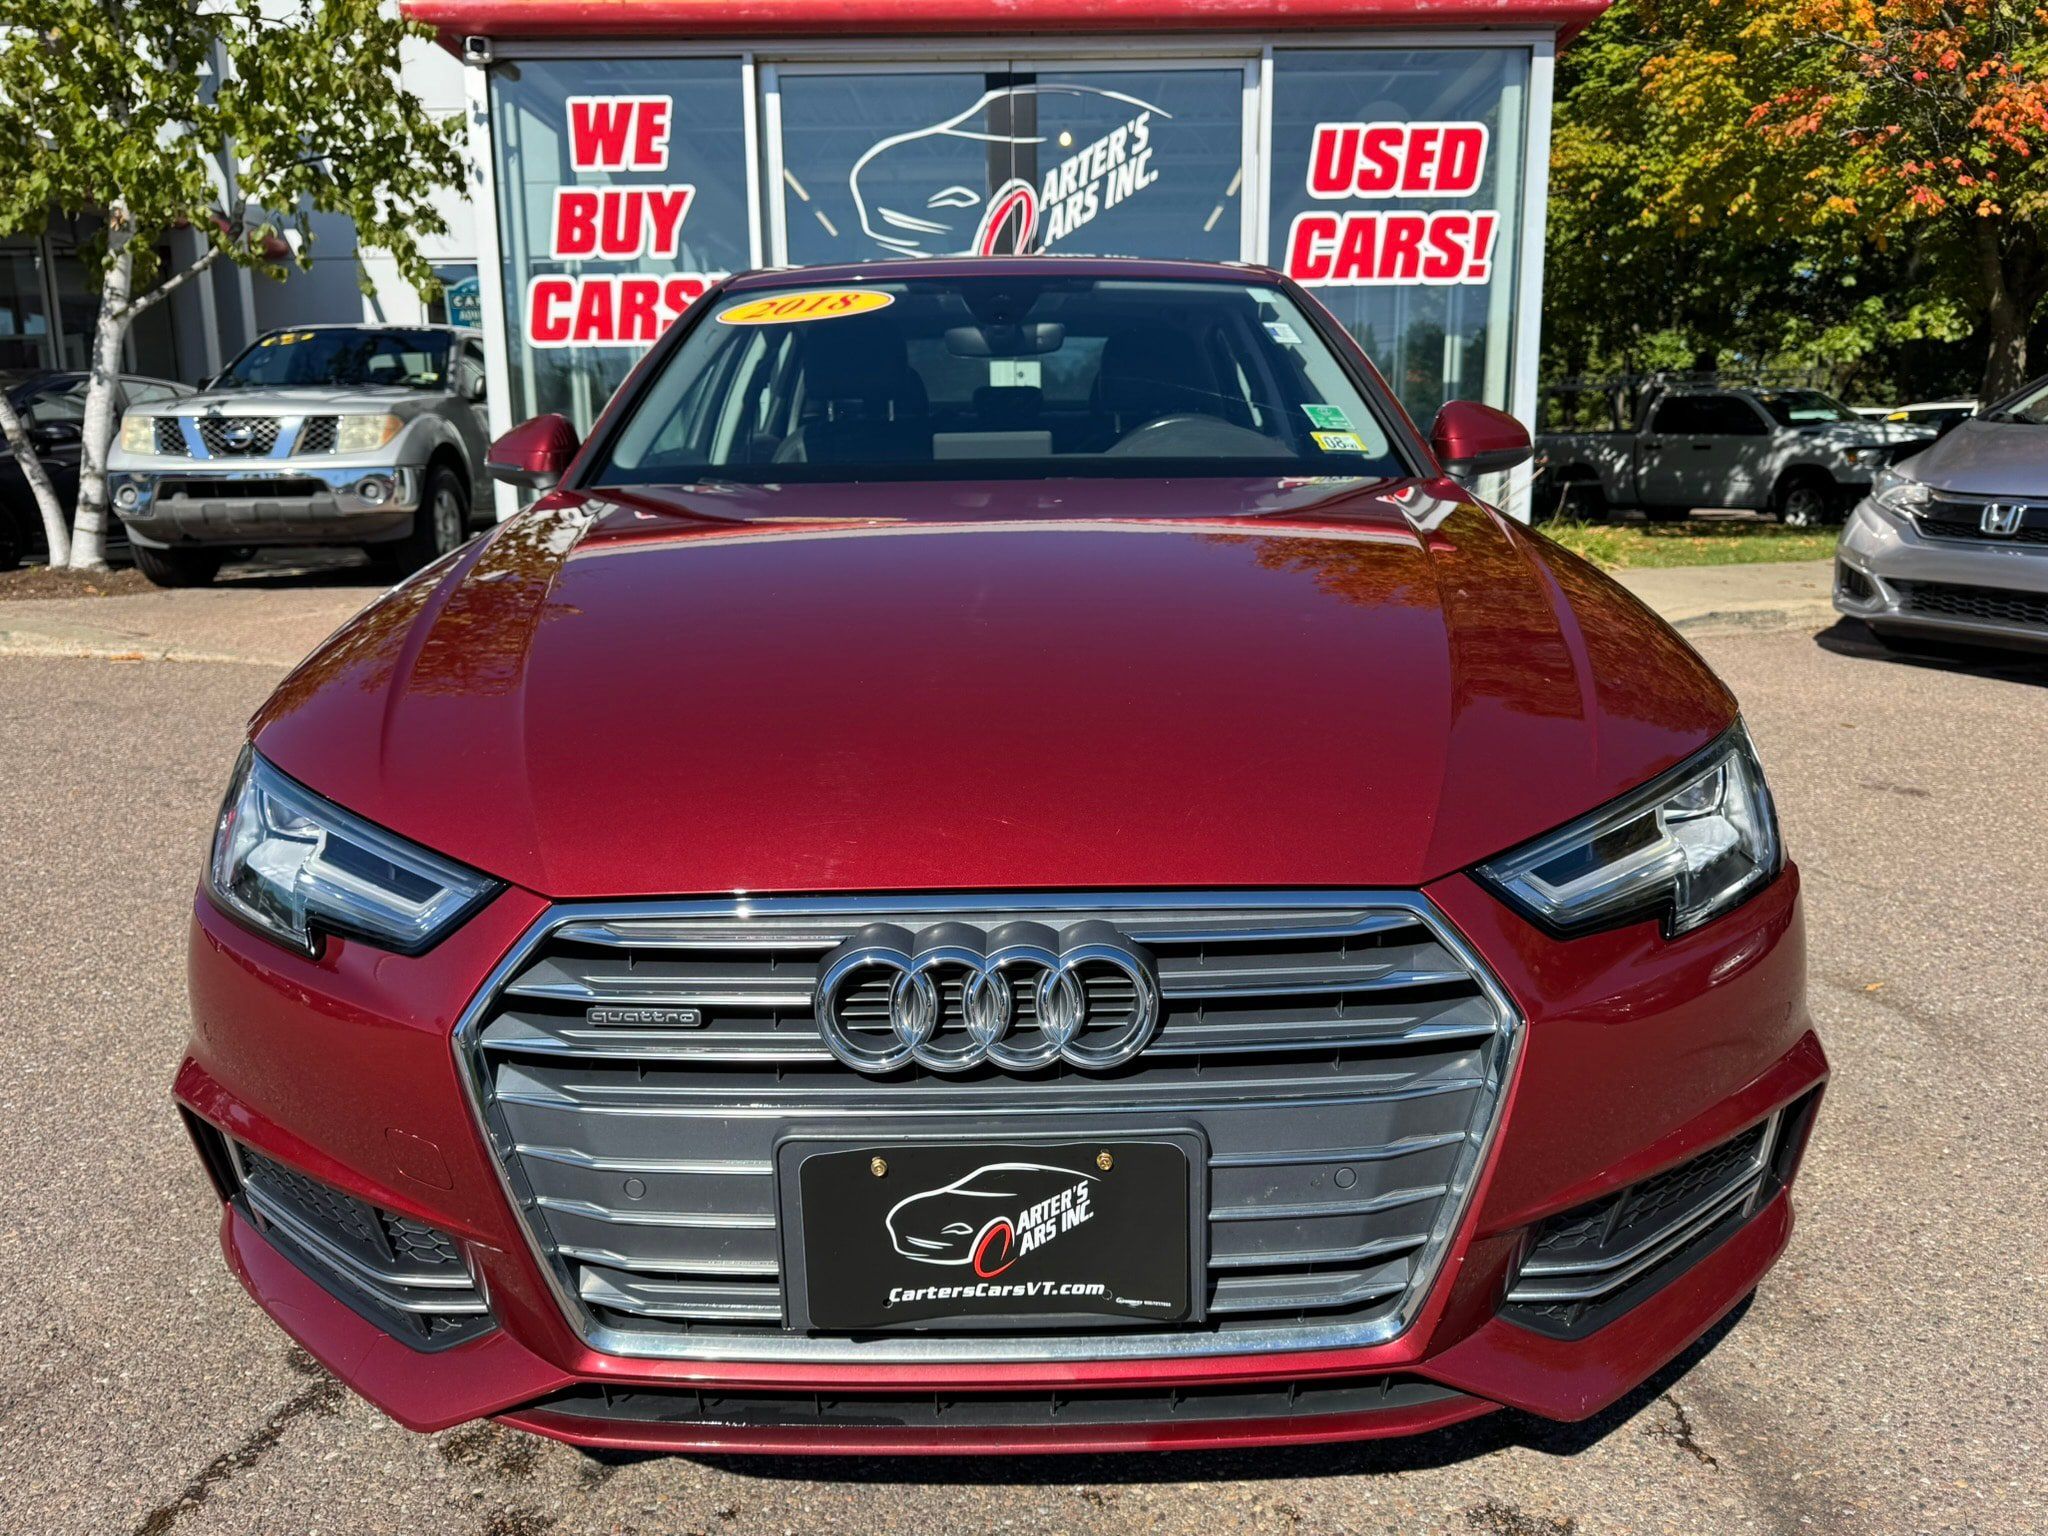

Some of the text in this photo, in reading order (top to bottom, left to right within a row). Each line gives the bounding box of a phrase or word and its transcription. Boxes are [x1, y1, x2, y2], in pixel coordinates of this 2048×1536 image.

[568, 97, 671, 169] WE
[1309, 124, 1487, 196] USED
[1104, 147, 1159, 210] INC.
[552, 186, 694, 258] BUY
[1286, 212, 1498, 285] CARS!
[529, 275, 728, 346] CARS
[743, 294, 861, 320] 2018
[591, 1010, 694, 1023] quattro
[1062, 1199, 1094, 1233] INC.
[889, 1281, 1105, 1303] CartersCarsVT.com
